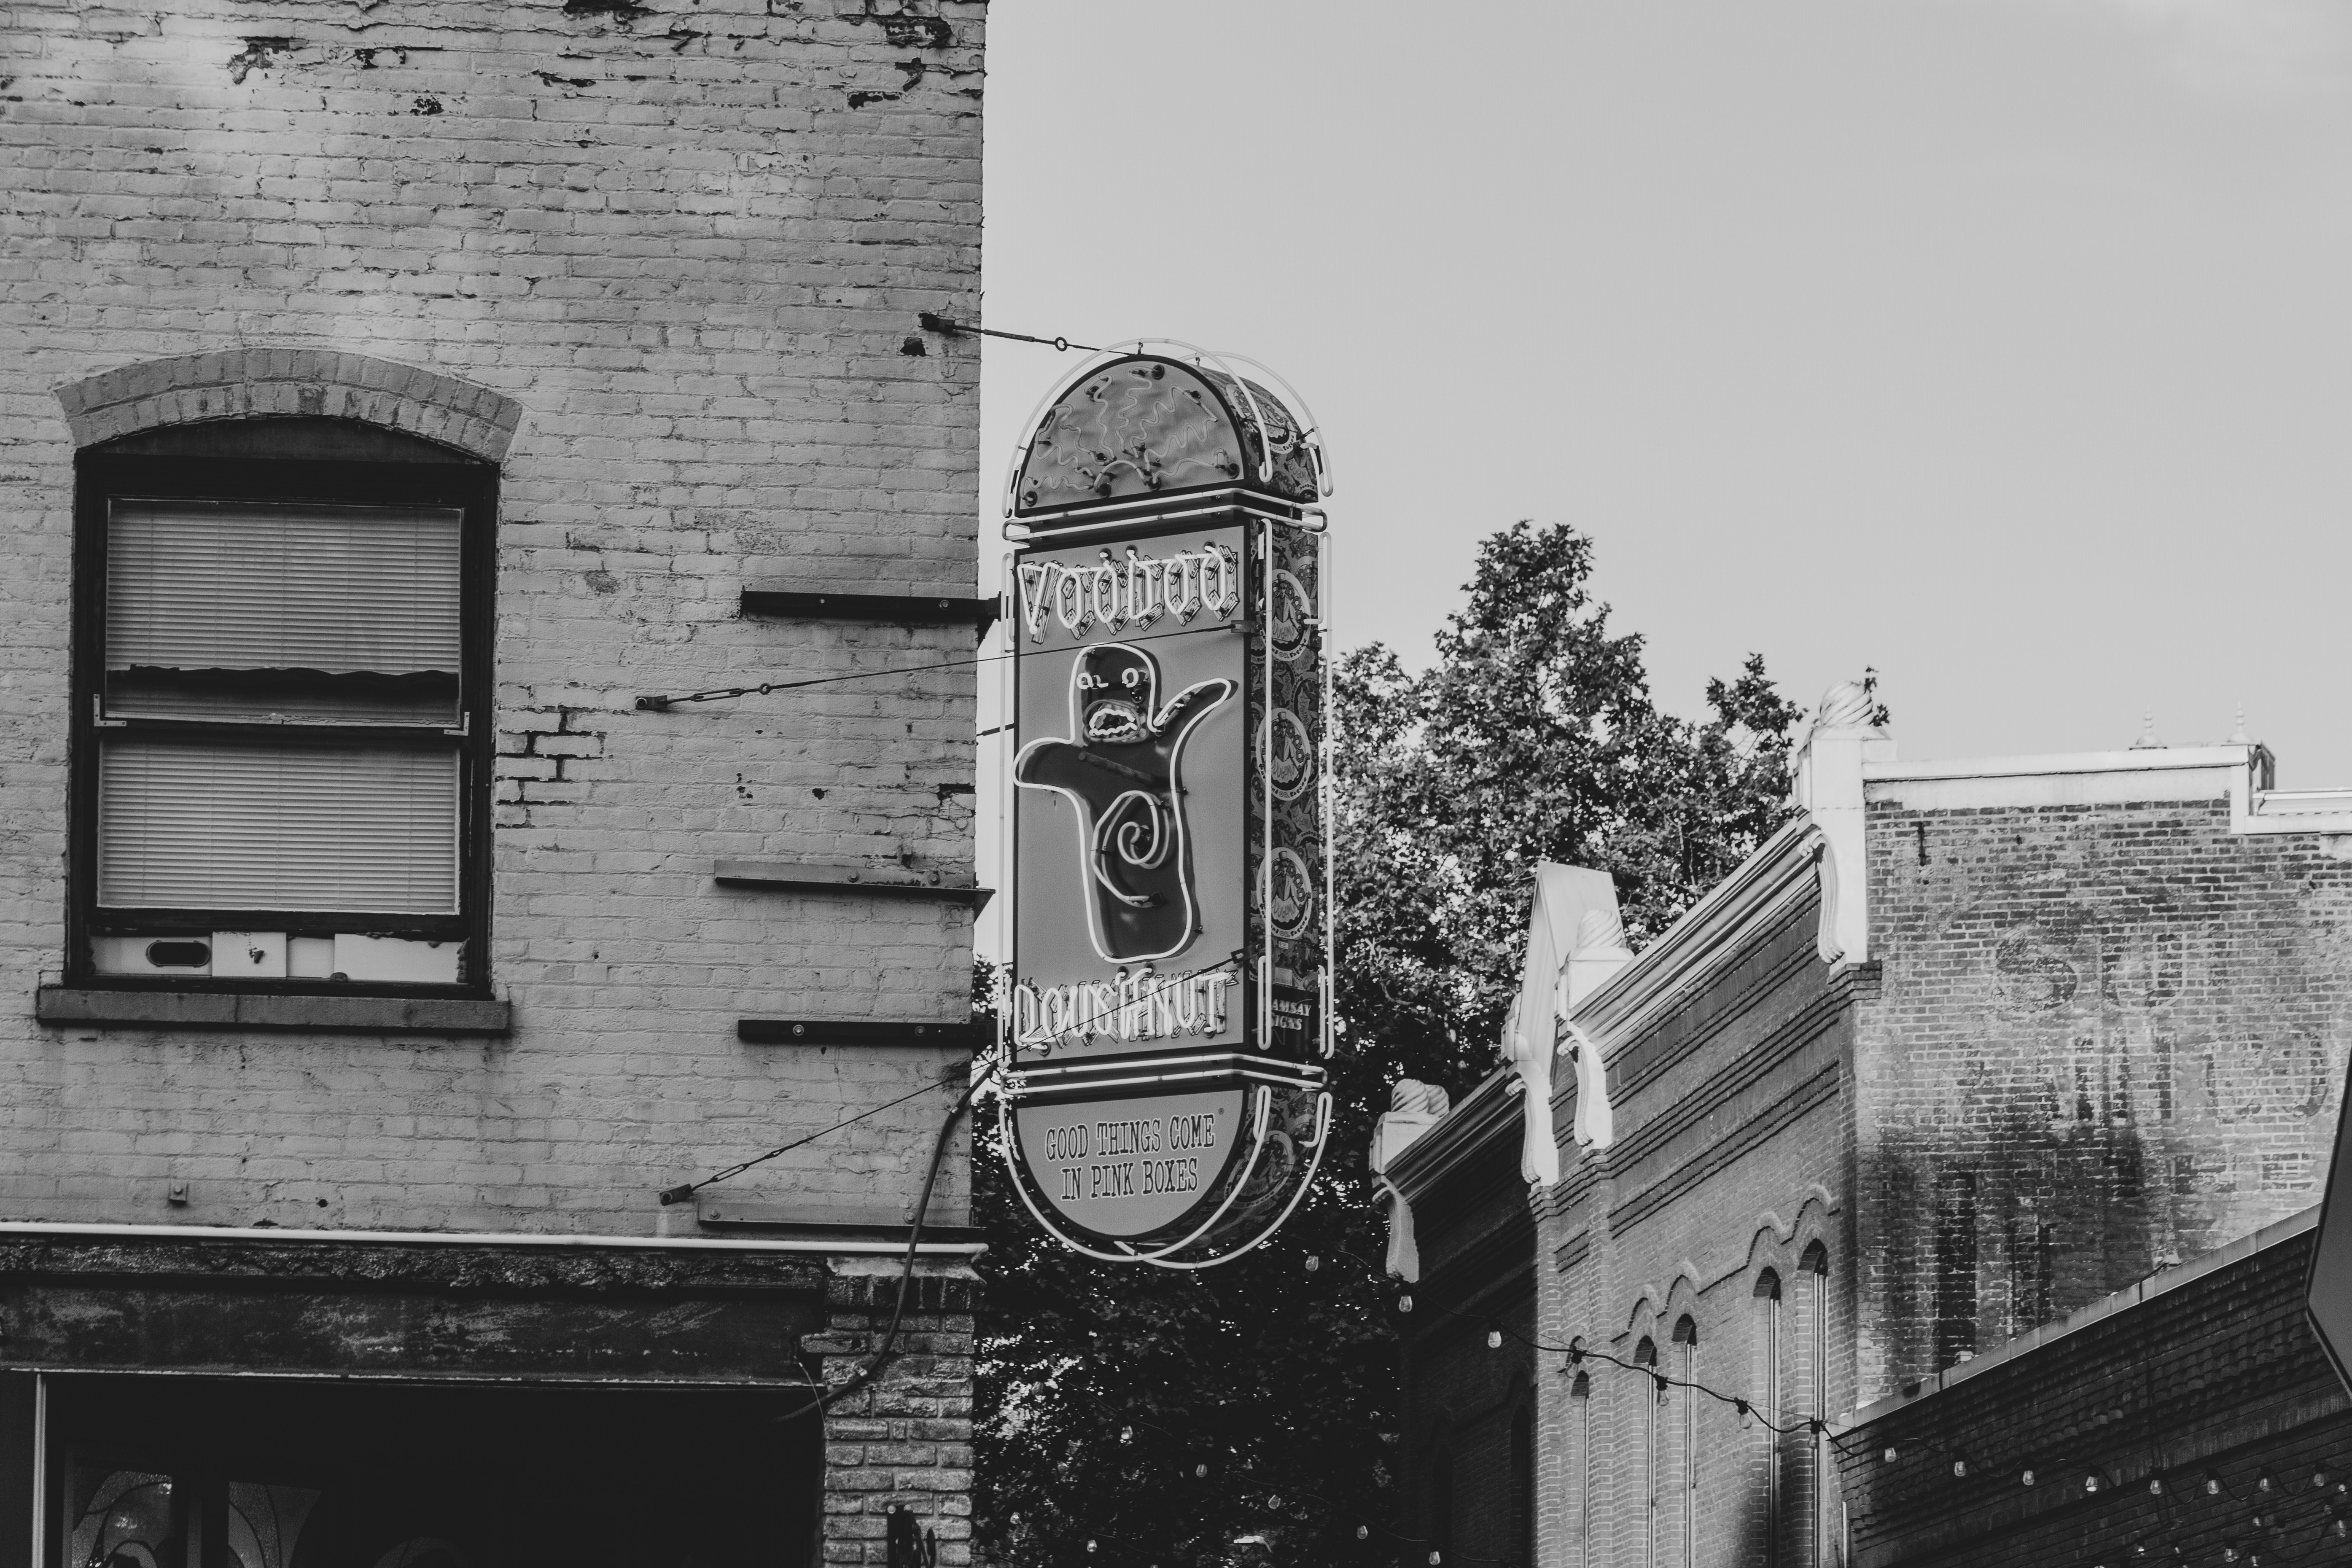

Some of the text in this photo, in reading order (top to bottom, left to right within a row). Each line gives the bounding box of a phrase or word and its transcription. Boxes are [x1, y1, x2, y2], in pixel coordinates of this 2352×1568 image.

[1017, 545, 1240, 644] VOODOO
[1271, 998, 1312, 1016] AMSAY
[1046, 1114, 1214, 1160] GOOD THINGS COME
[1061, 1167, 1081, 1200] IN
[1091, 1162, 1134, 1198] PINK
[1142, 1157, 1198, 1194] BOXES
